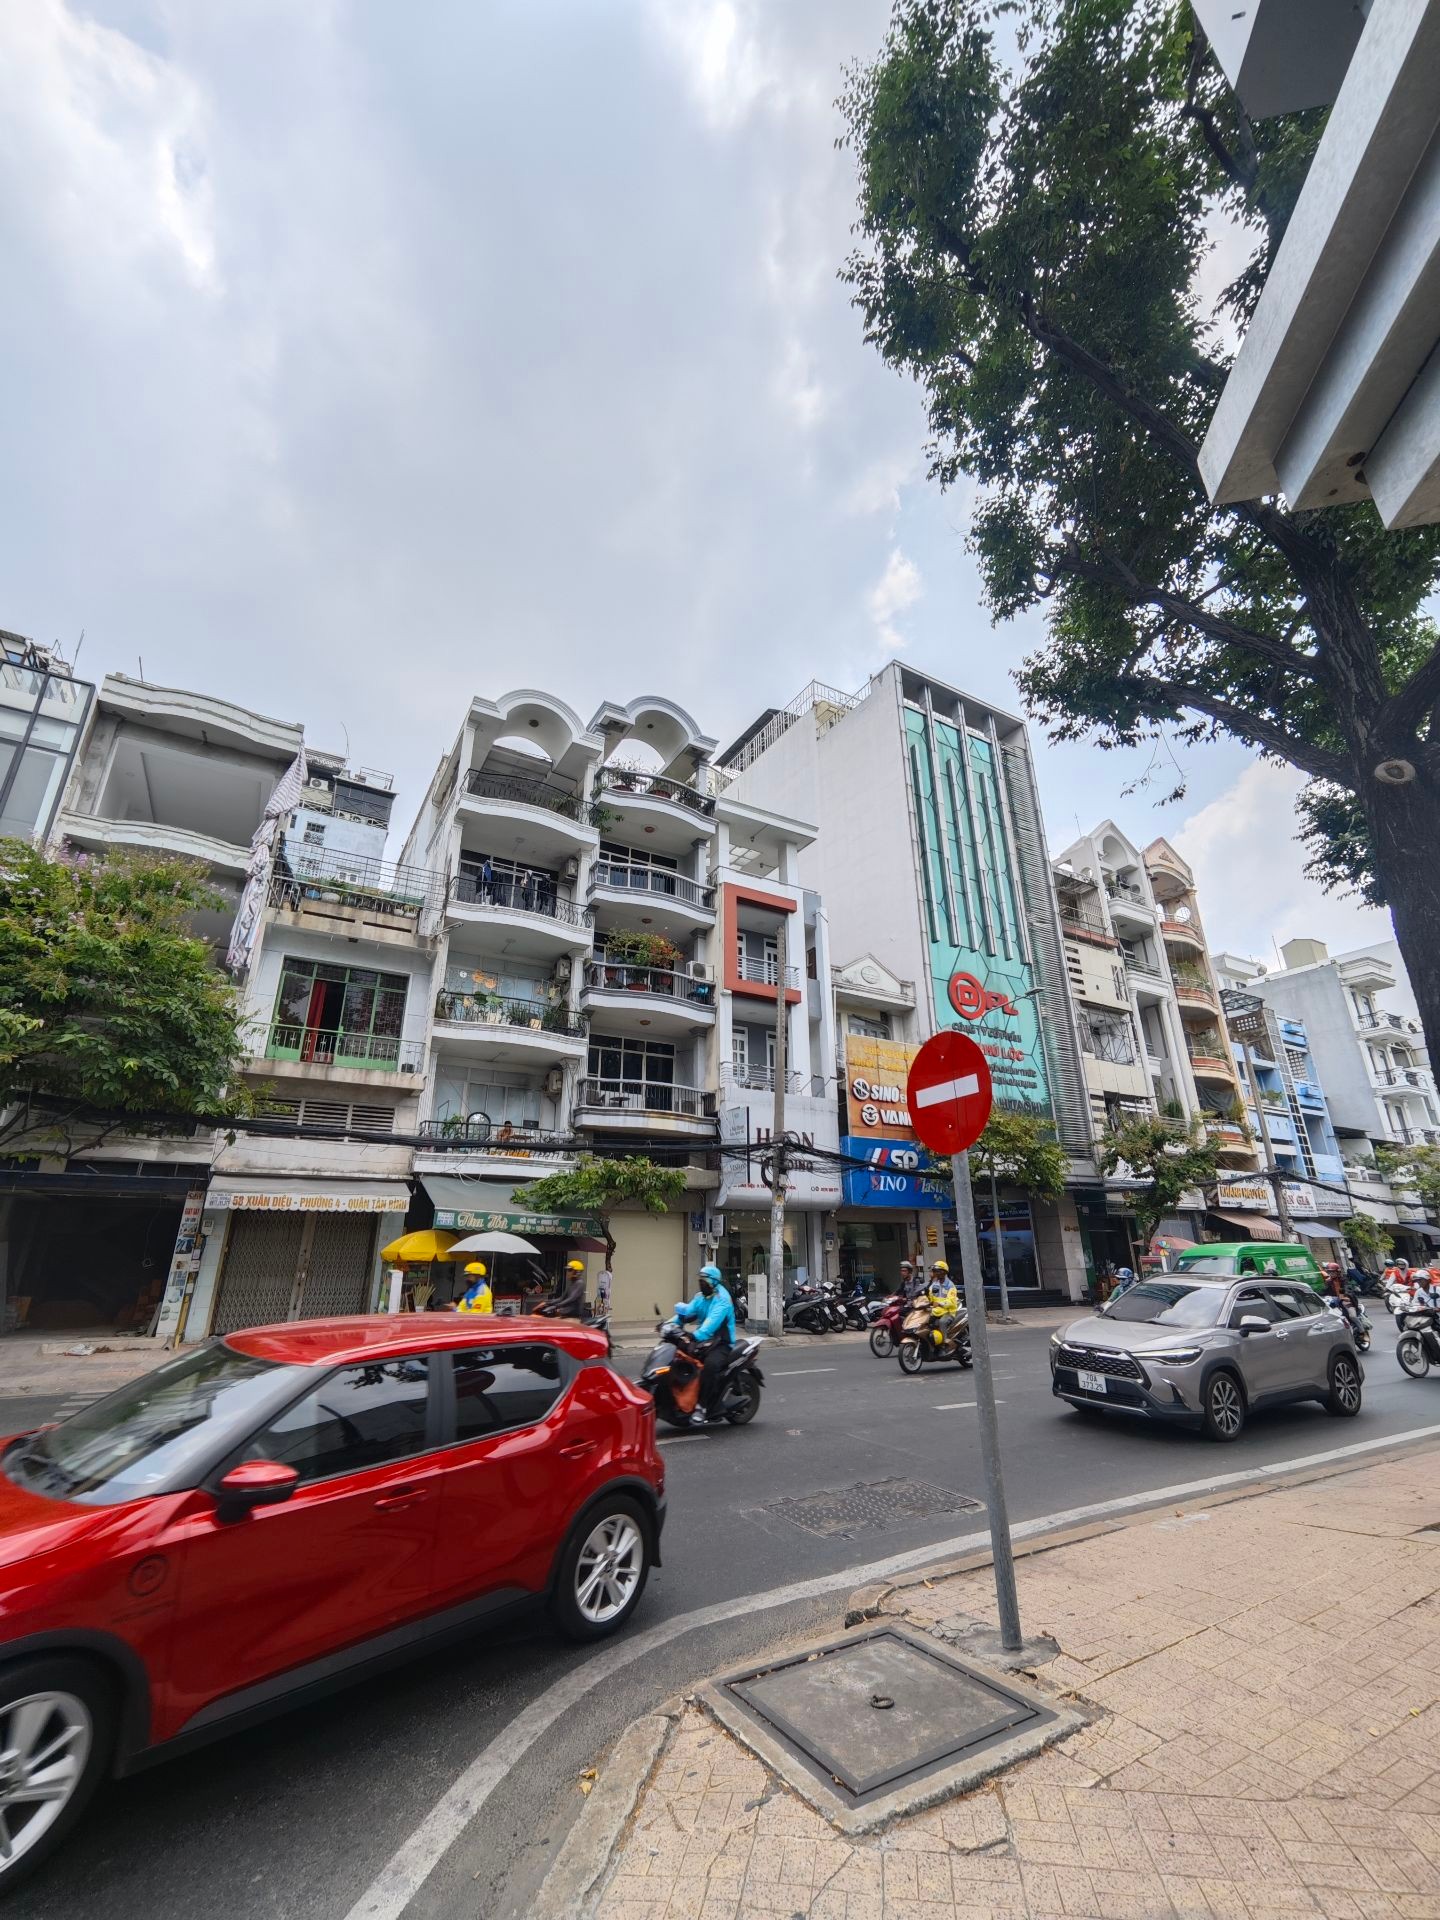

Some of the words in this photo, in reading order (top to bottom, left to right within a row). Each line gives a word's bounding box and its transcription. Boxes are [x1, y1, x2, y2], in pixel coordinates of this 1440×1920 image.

[871, 1084, 900, 1103] SINO
[880, 1108, 913, 1127] VAN
[756, 1127, 815, 1149] HON
[871, 1175, 907, 1192] SINO
[233, 1195, 244, 1206] 58
[245, 1193, 270, 1207] XUÂN
[272, 1194, 292, 1209] DIỆU
[1081, 1380, 1104, 1392] 373.25
